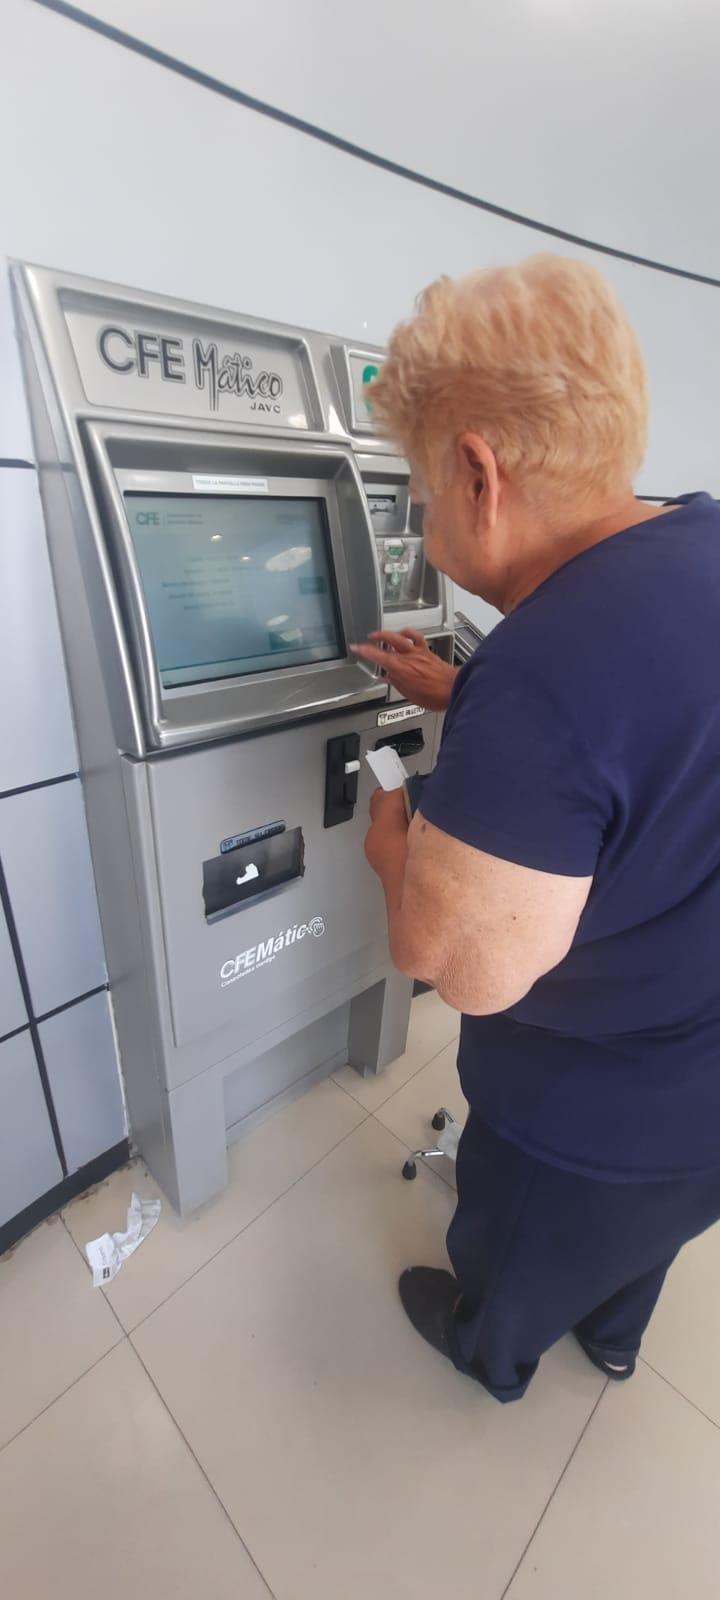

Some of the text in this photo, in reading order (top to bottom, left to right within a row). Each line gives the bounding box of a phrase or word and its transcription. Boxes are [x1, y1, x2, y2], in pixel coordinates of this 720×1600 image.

[99, 326, 185, 383] CFE
[250, 403, 280, 413] JAVC
[136, 512, 160, 526] CFE
